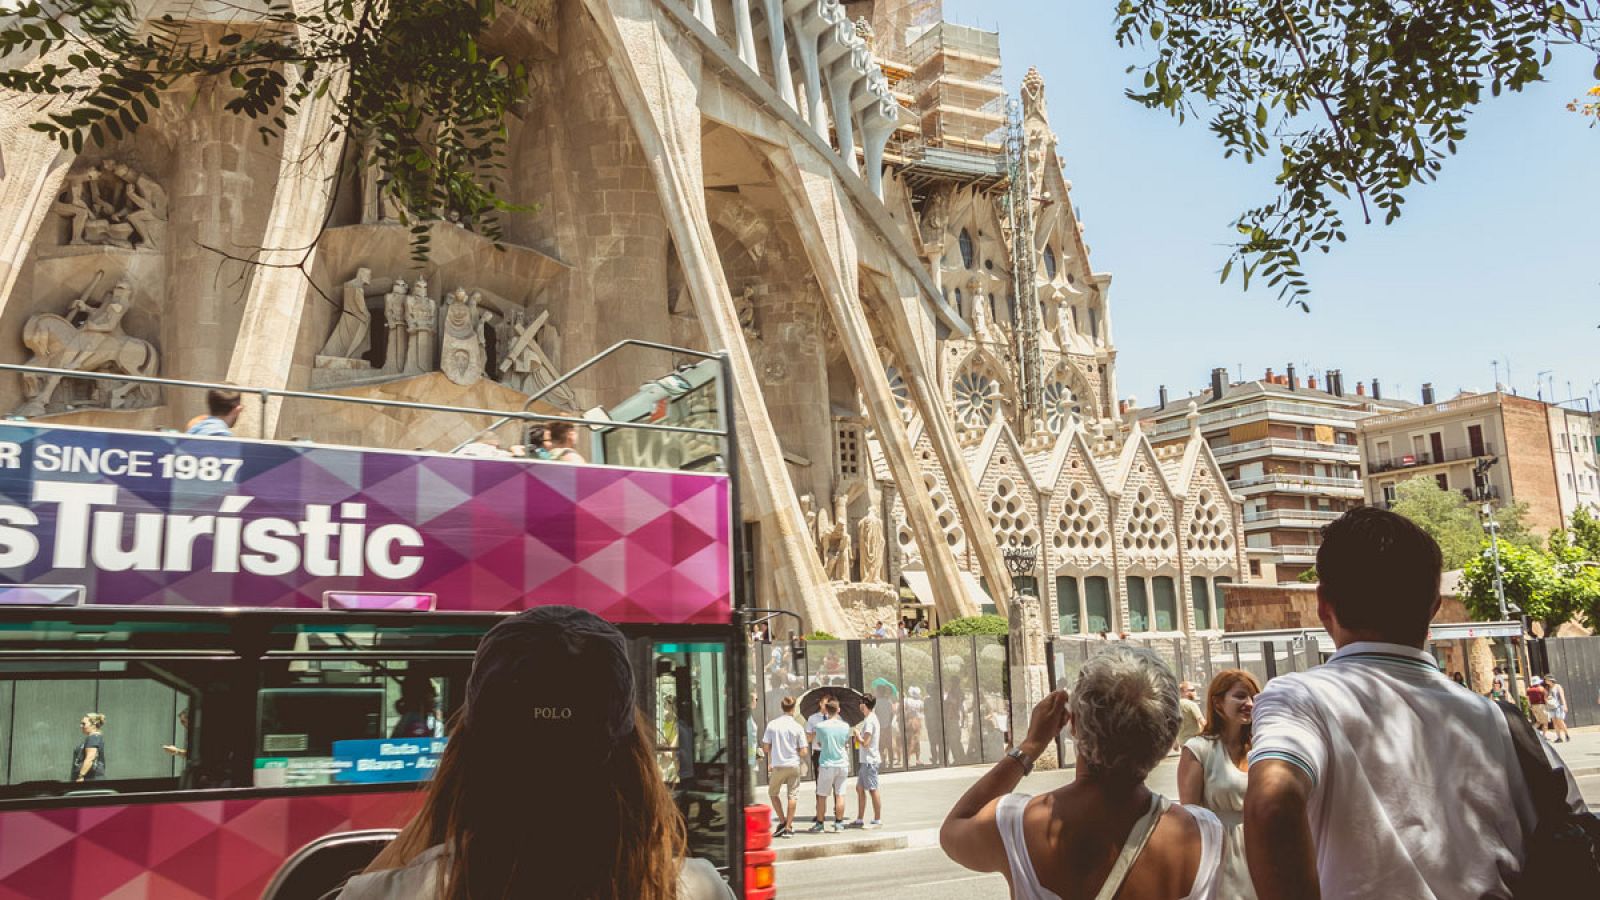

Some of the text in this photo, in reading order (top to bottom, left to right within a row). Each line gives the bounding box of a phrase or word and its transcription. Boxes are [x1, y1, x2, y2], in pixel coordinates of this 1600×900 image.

[33, 445, 153, 478] SINCE
[157, 453, 244, 483] 1987
[534, 707, 572, 719] POLO
